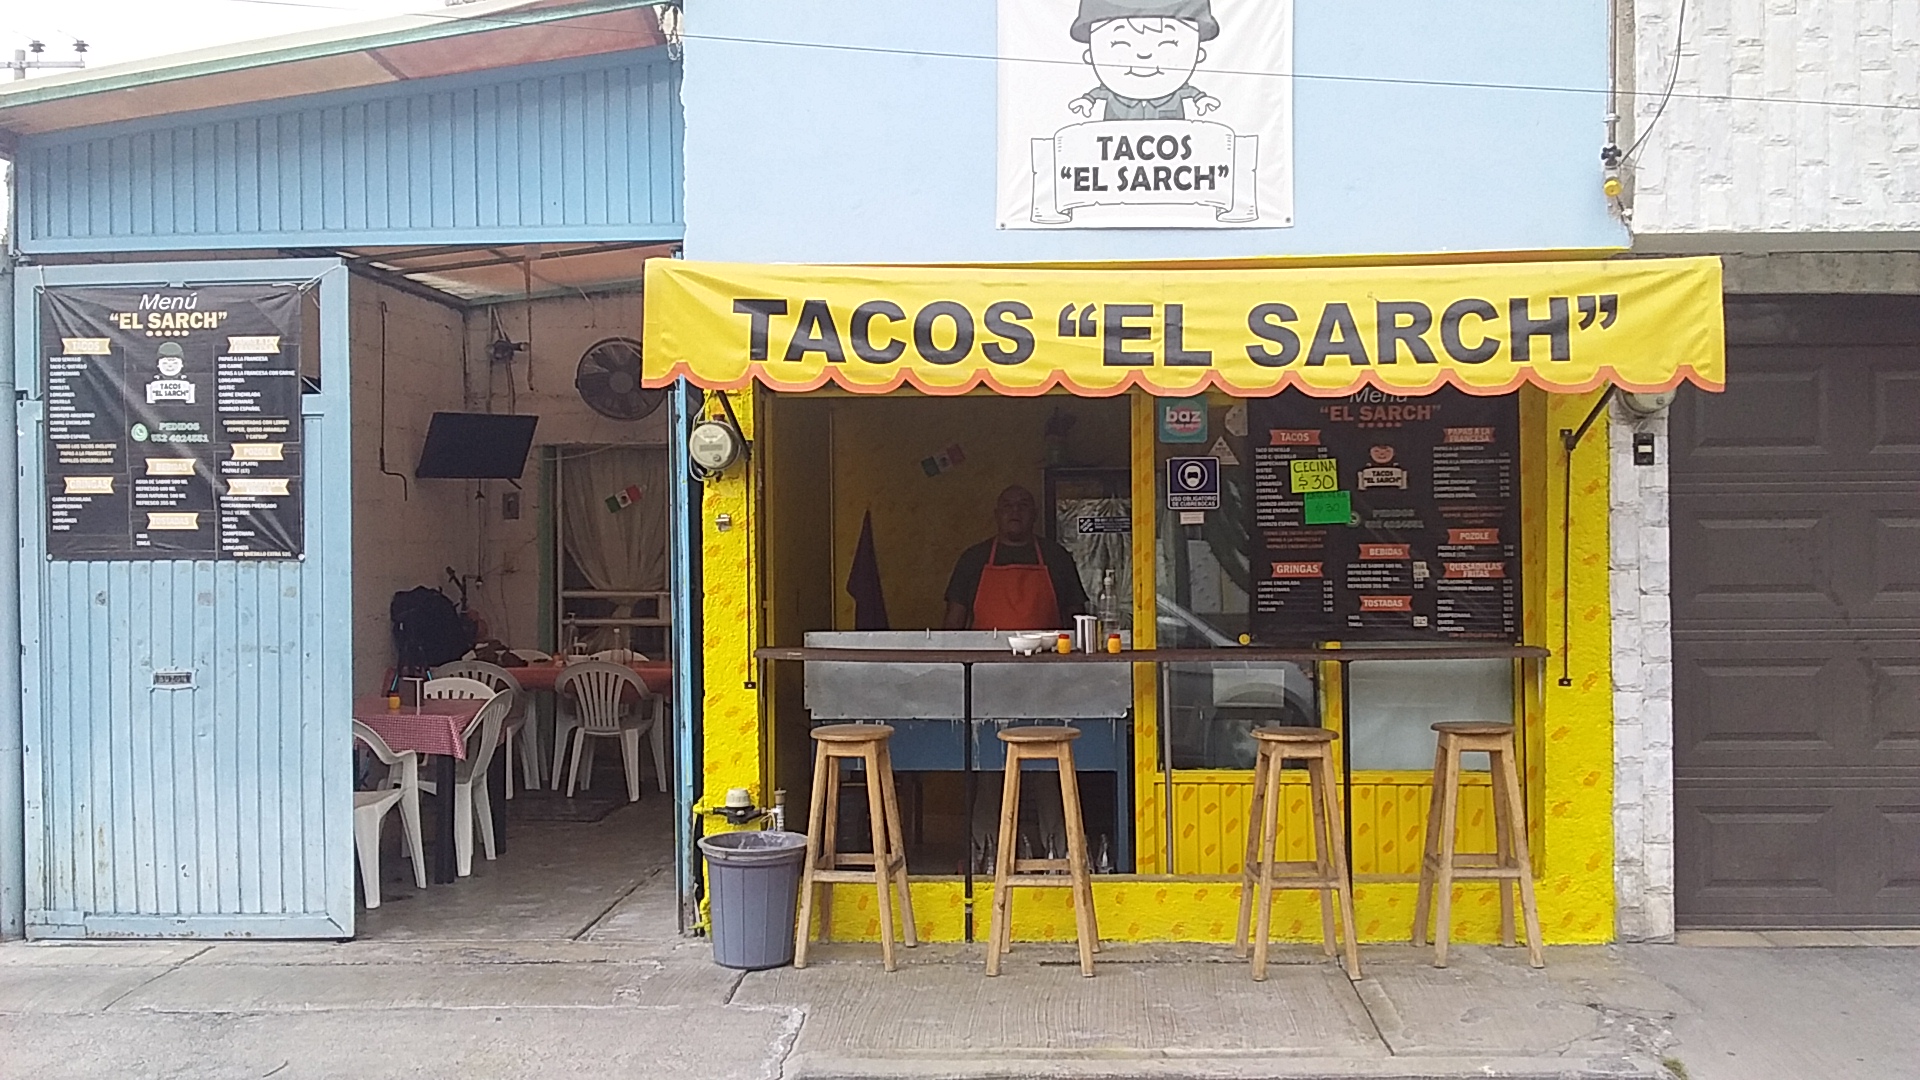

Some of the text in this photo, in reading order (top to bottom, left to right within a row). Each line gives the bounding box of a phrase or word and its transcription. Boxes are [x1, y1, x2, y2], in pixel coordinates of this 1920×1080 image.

[1096, 134, 1192, 161] TACOS
[139, 292, 197, 310] Menú
[733, 299, 1035, 365] TACOS
[71, 342, 100, 351] TACOS
[1166, 406, 1201, 422] baz
[1280, 432, 1310, 442] TACOS
[1293, 462, 1336, 474] CECINA
[1460, 532, 1489, 540] POZOLE
[1369, 548, 1403, 556] BEBIDAS
[1276, 564, 1319, 573] GRINGAS
[1449, 562, 1502, 571] QUESADILLAS
[1363, 599, 1403, 607] TOSTADAS
